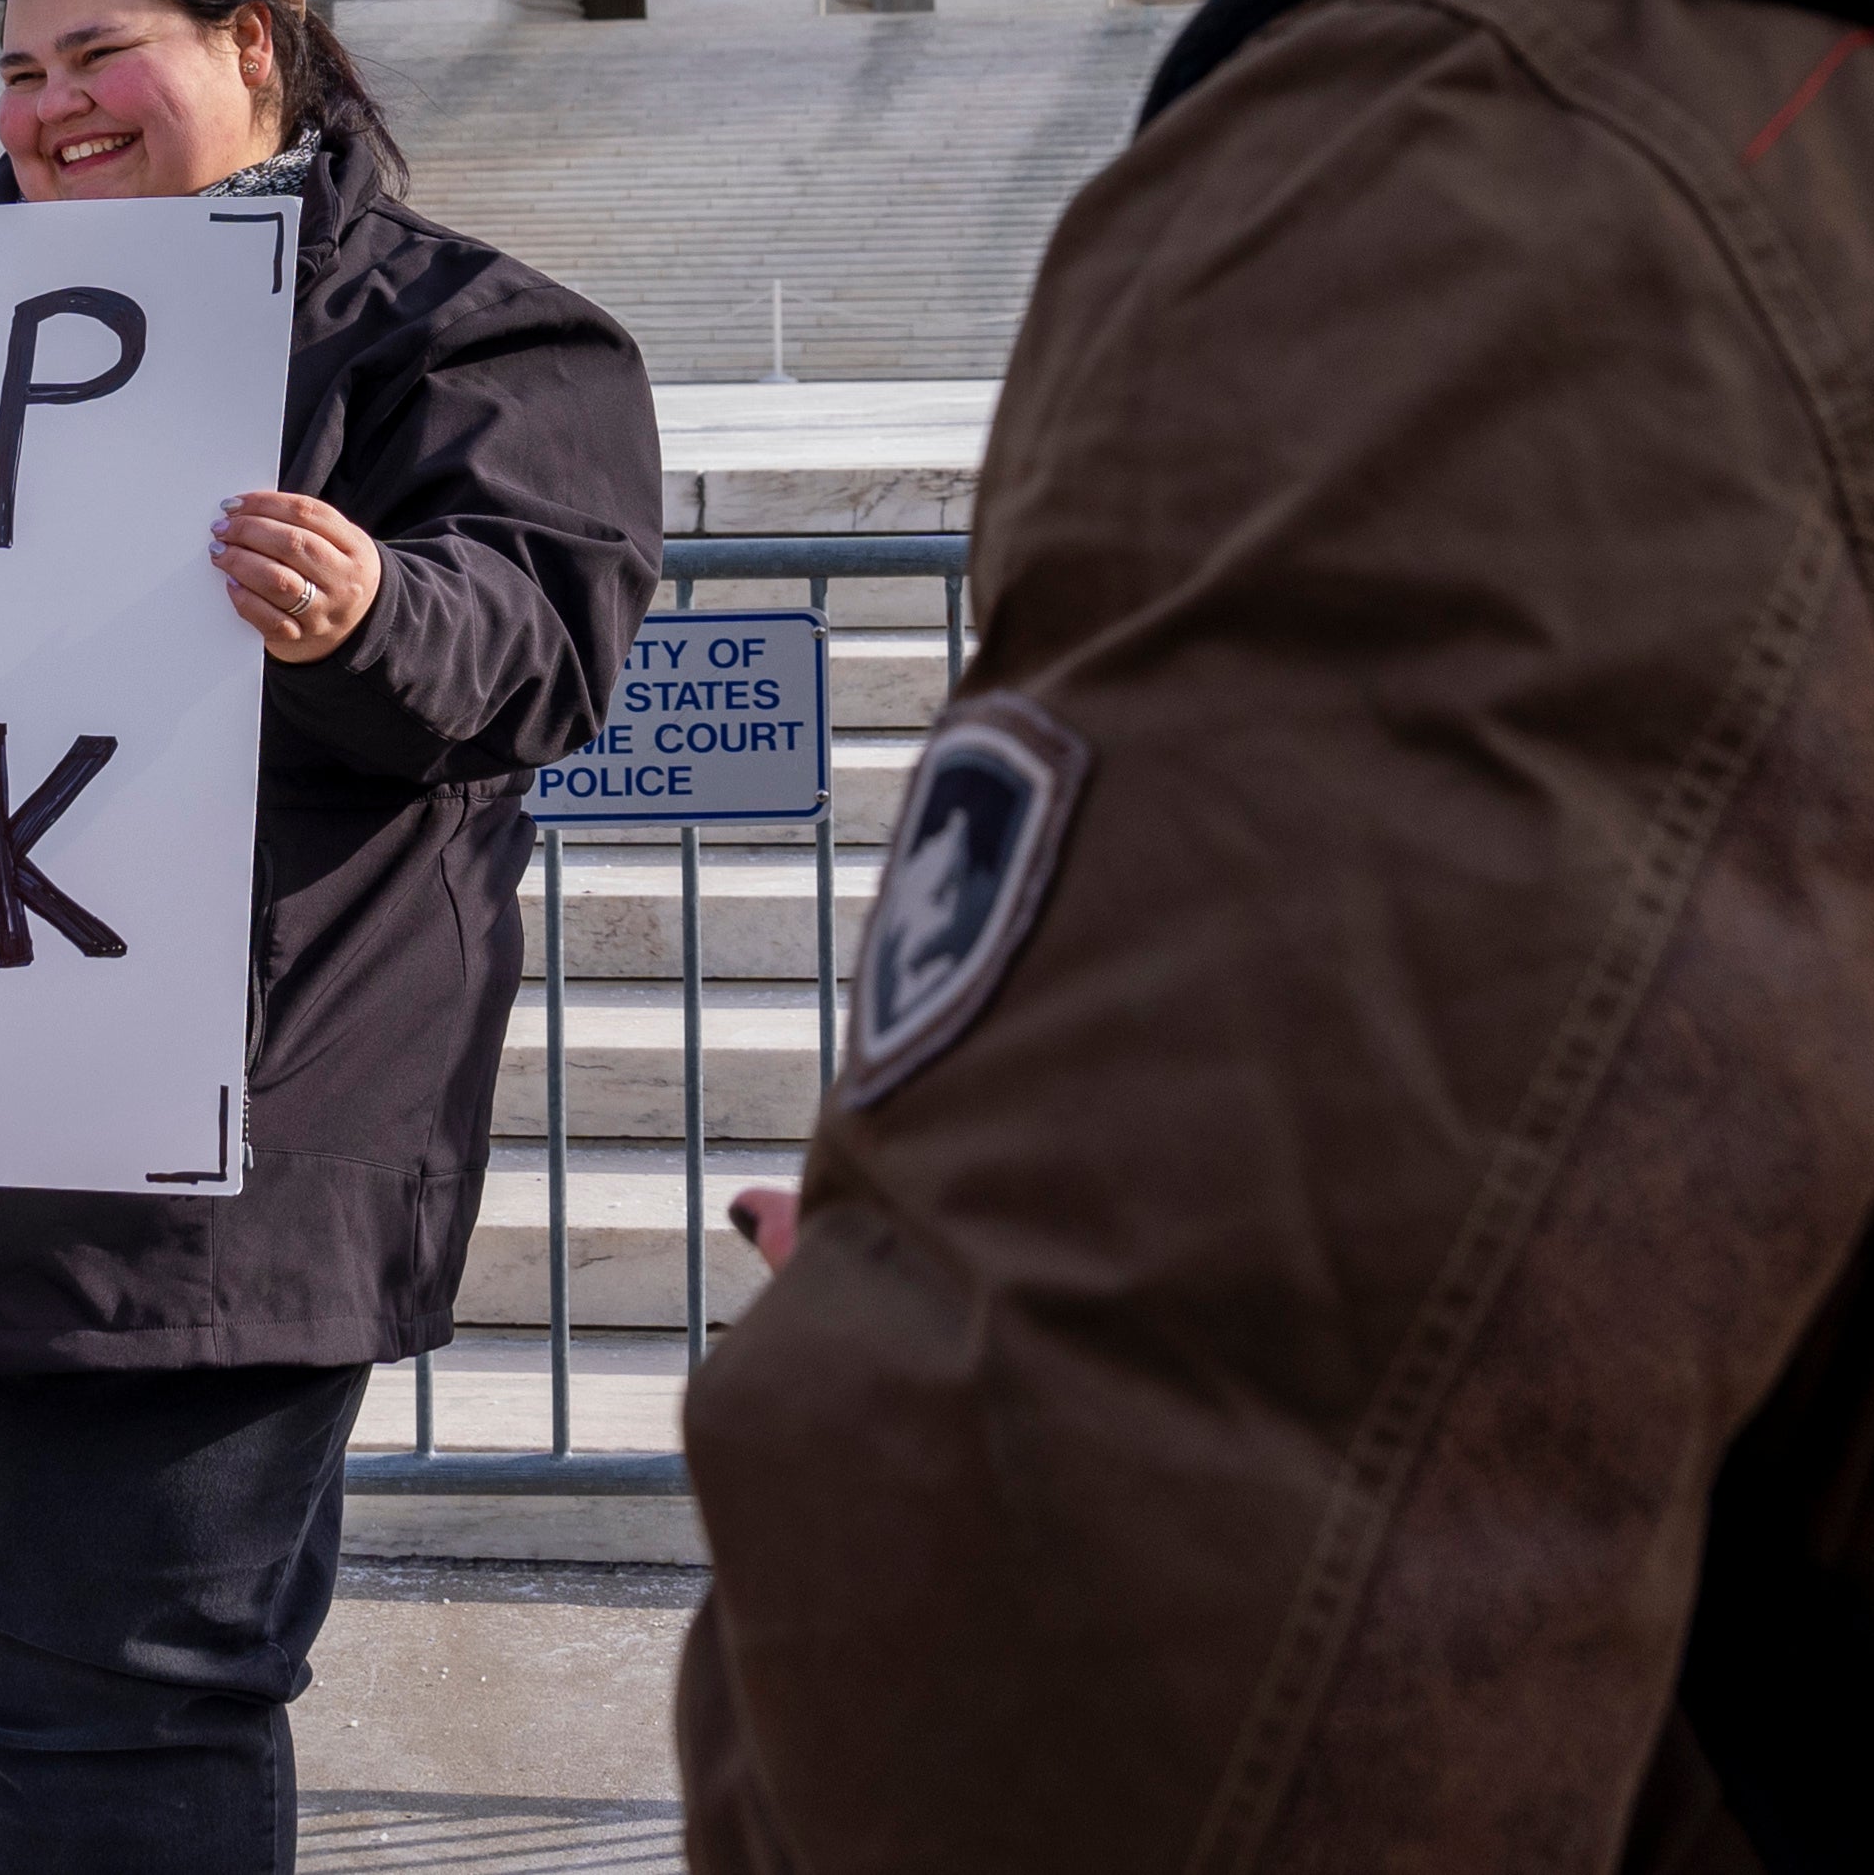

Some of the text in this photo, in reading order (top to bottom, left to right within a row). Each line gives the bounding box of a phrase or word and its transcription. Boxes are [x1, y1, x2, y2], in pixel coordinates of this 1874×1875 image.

[708, 638, 767, 669] OF
[625, 679, 780, 713] STATES
[654, 721, 804, 754] COURT
[540, 765, 693, 798] POLICE
